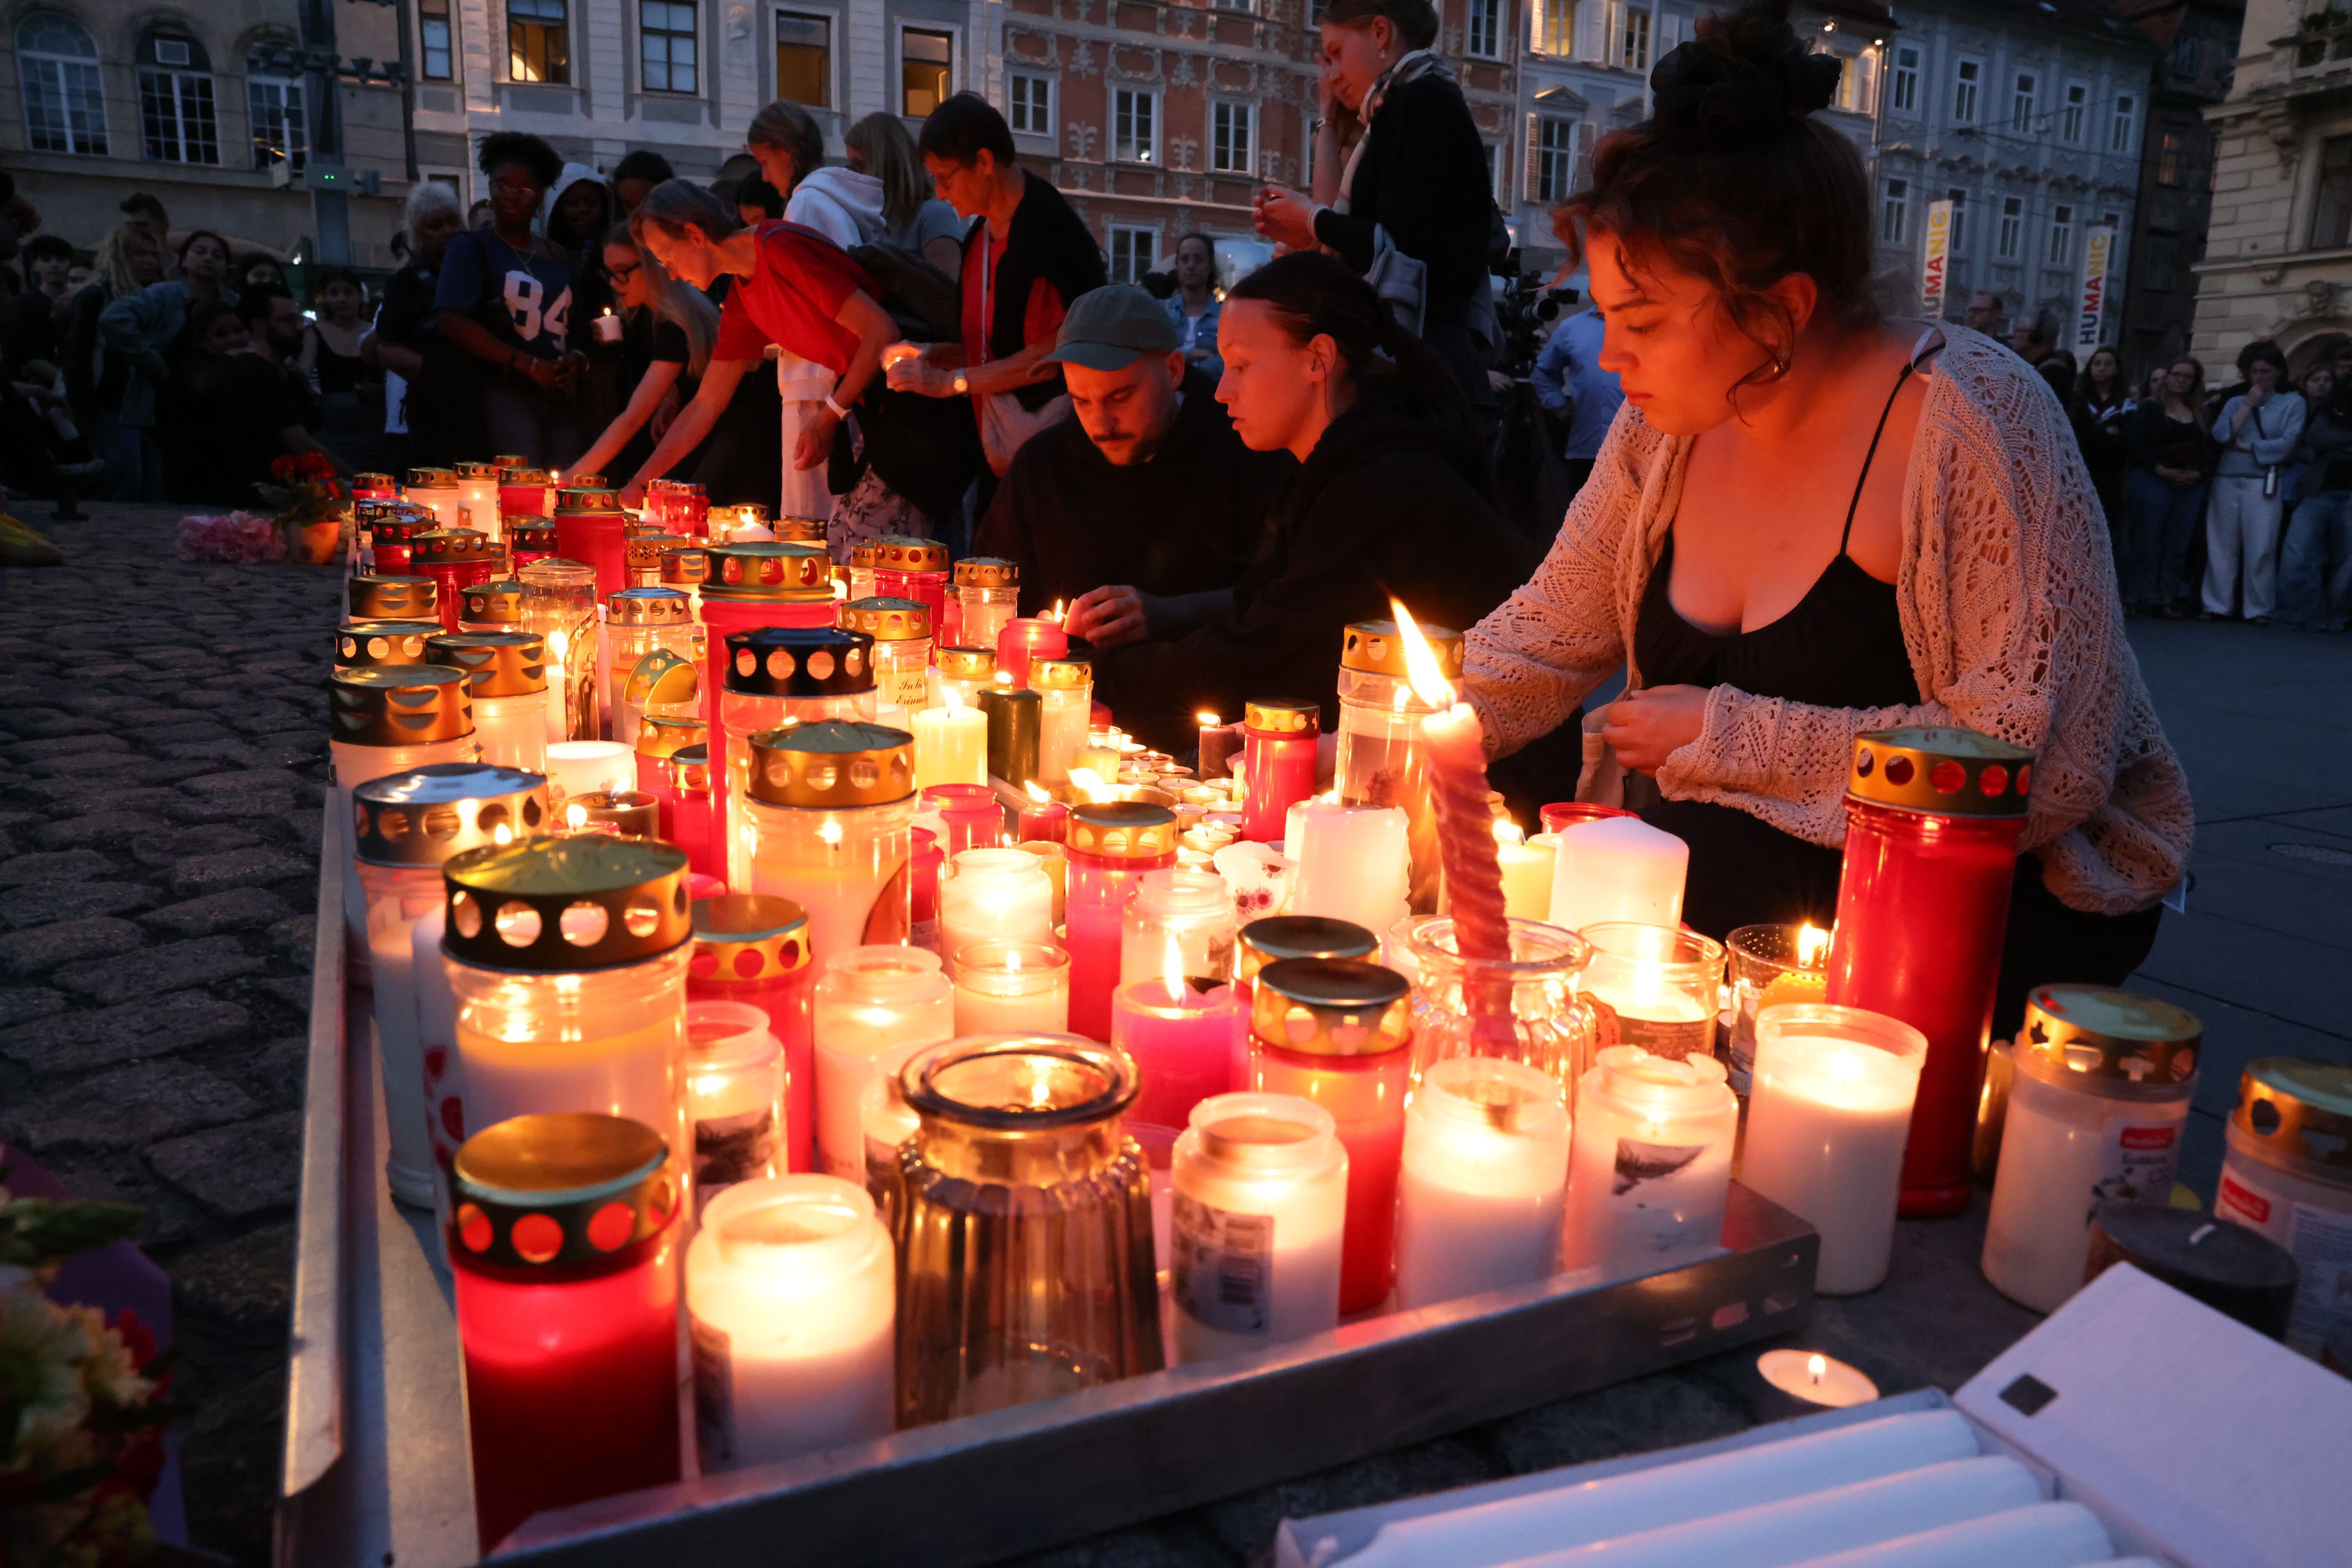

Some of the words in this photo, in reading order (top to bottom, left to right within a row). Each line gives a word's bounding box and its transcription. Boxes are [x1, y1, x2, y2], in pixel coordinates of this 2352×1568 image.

[503, 270, 573, 352] 84
[2079, 235, 2107, 345] HUMANIC
[899, 679, 913, 690] In
